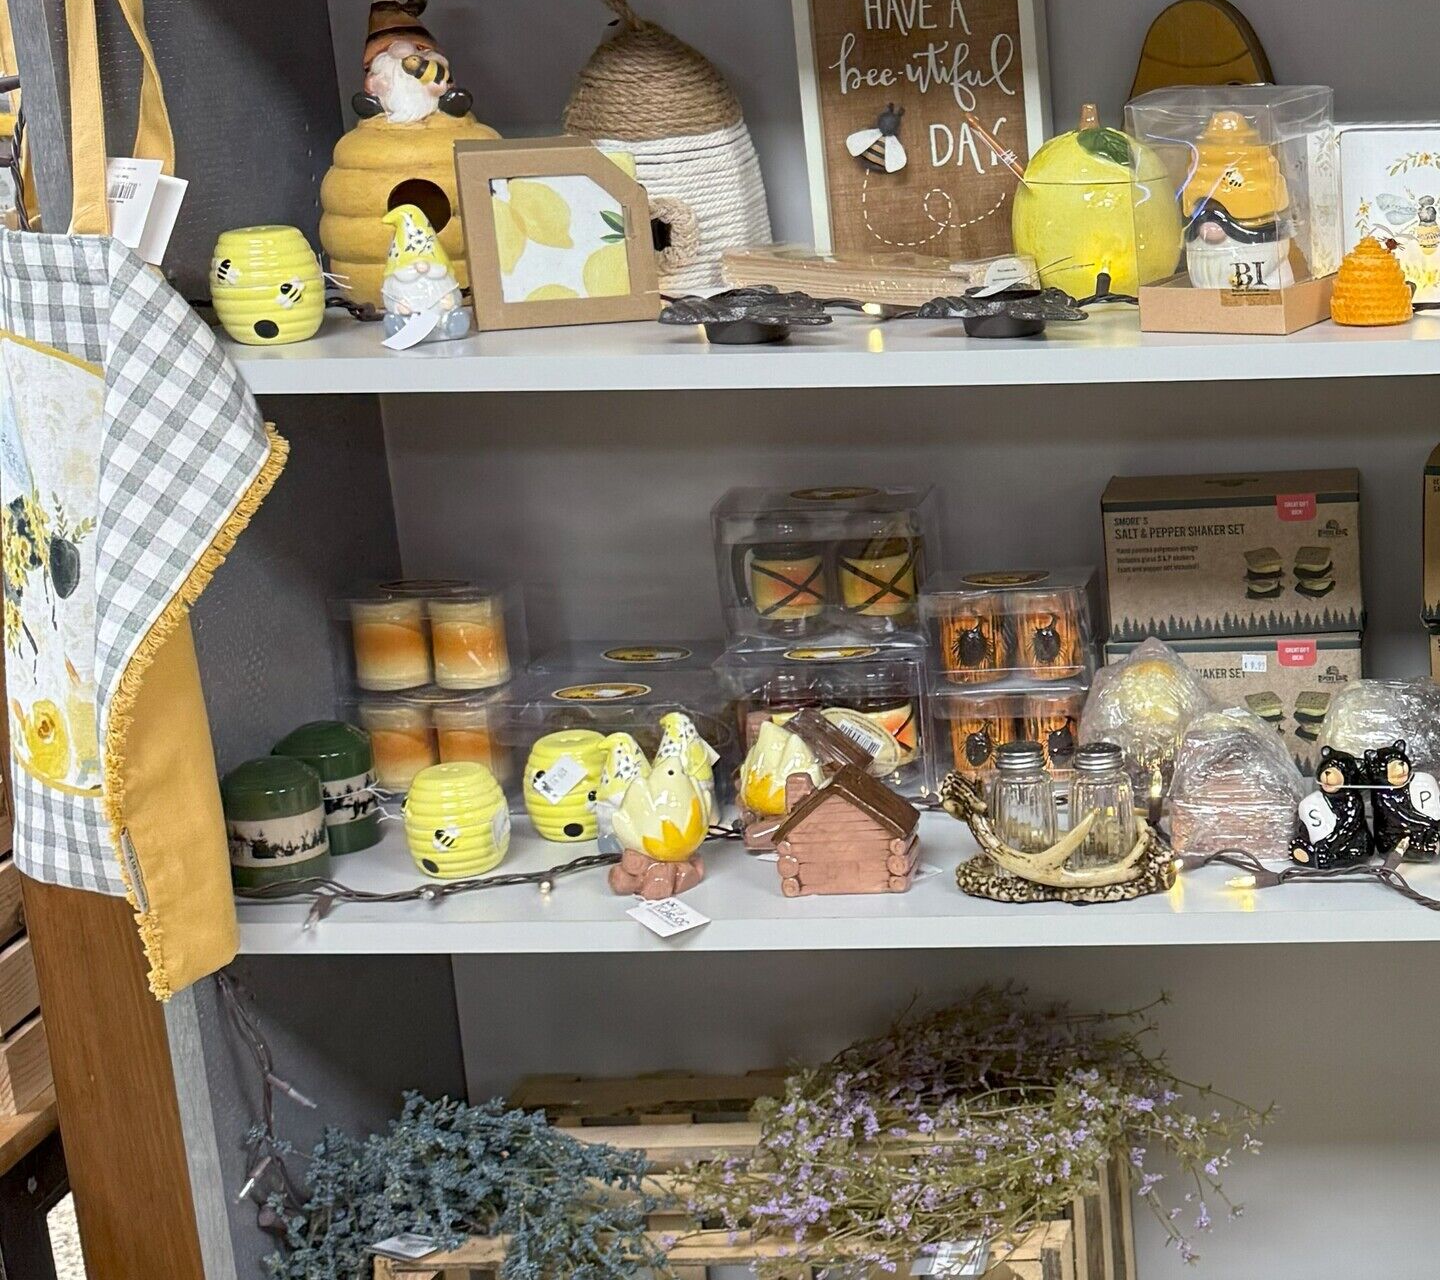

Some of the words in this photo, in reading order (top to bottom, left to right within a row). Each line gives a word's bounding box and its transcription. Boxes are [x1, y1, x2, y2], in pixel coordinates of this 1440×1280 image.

[829, 33, 1016, 112] bee-utiful
[929, 117, 1007, 174] DAY
[1115, 529, 1139, 540] SALT
[1140, 528, 1147, 539] &
[1150, 527, 1186, 538] PEPPER
[1188, 525, 1226, 537] SHAKER
[1228, 523, 1246, 535] SET
[1229, 668, 1246, 678] SET
[1420, 790, 1431, 809] P
[1308, 809, 1321, 827] S
